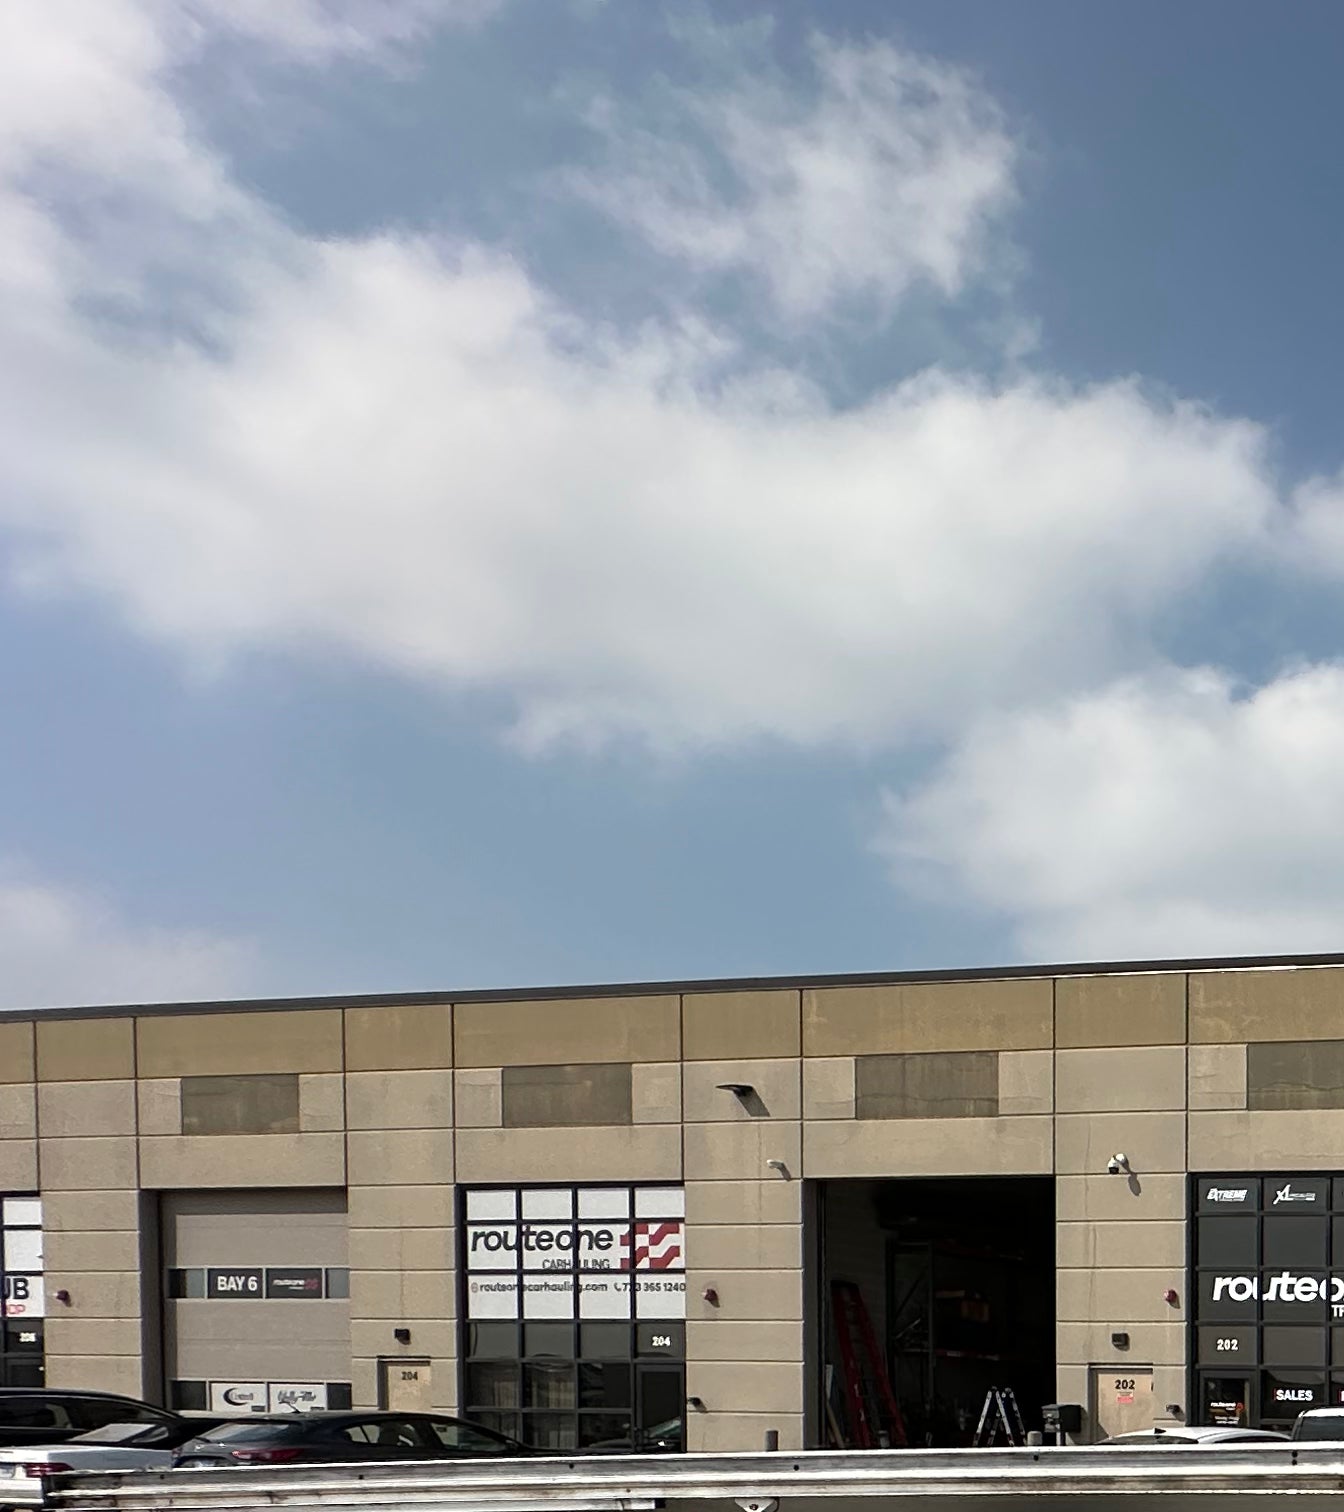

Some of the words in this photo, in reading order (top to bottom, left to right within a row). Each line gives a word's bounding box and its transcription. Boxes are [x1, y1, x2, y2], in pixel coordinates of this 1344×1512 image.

[471, 1225, 614, 1251] routeone
[542, 1258, 610, 1269] CARHULING
[217, 1276, 245, 1291] BAY
[247, 1276, 258, 1291] 6
[643, 1282, 661, 1292] 365
[652, 1336, 671, 1347] 204
[1216, 1338, 1239, 1351] 202
[401, 1371, 418, 1381] 204
[1115, 1379, 1135, 1390] 202
[1276, 1389, 1313, 1401] SALES
